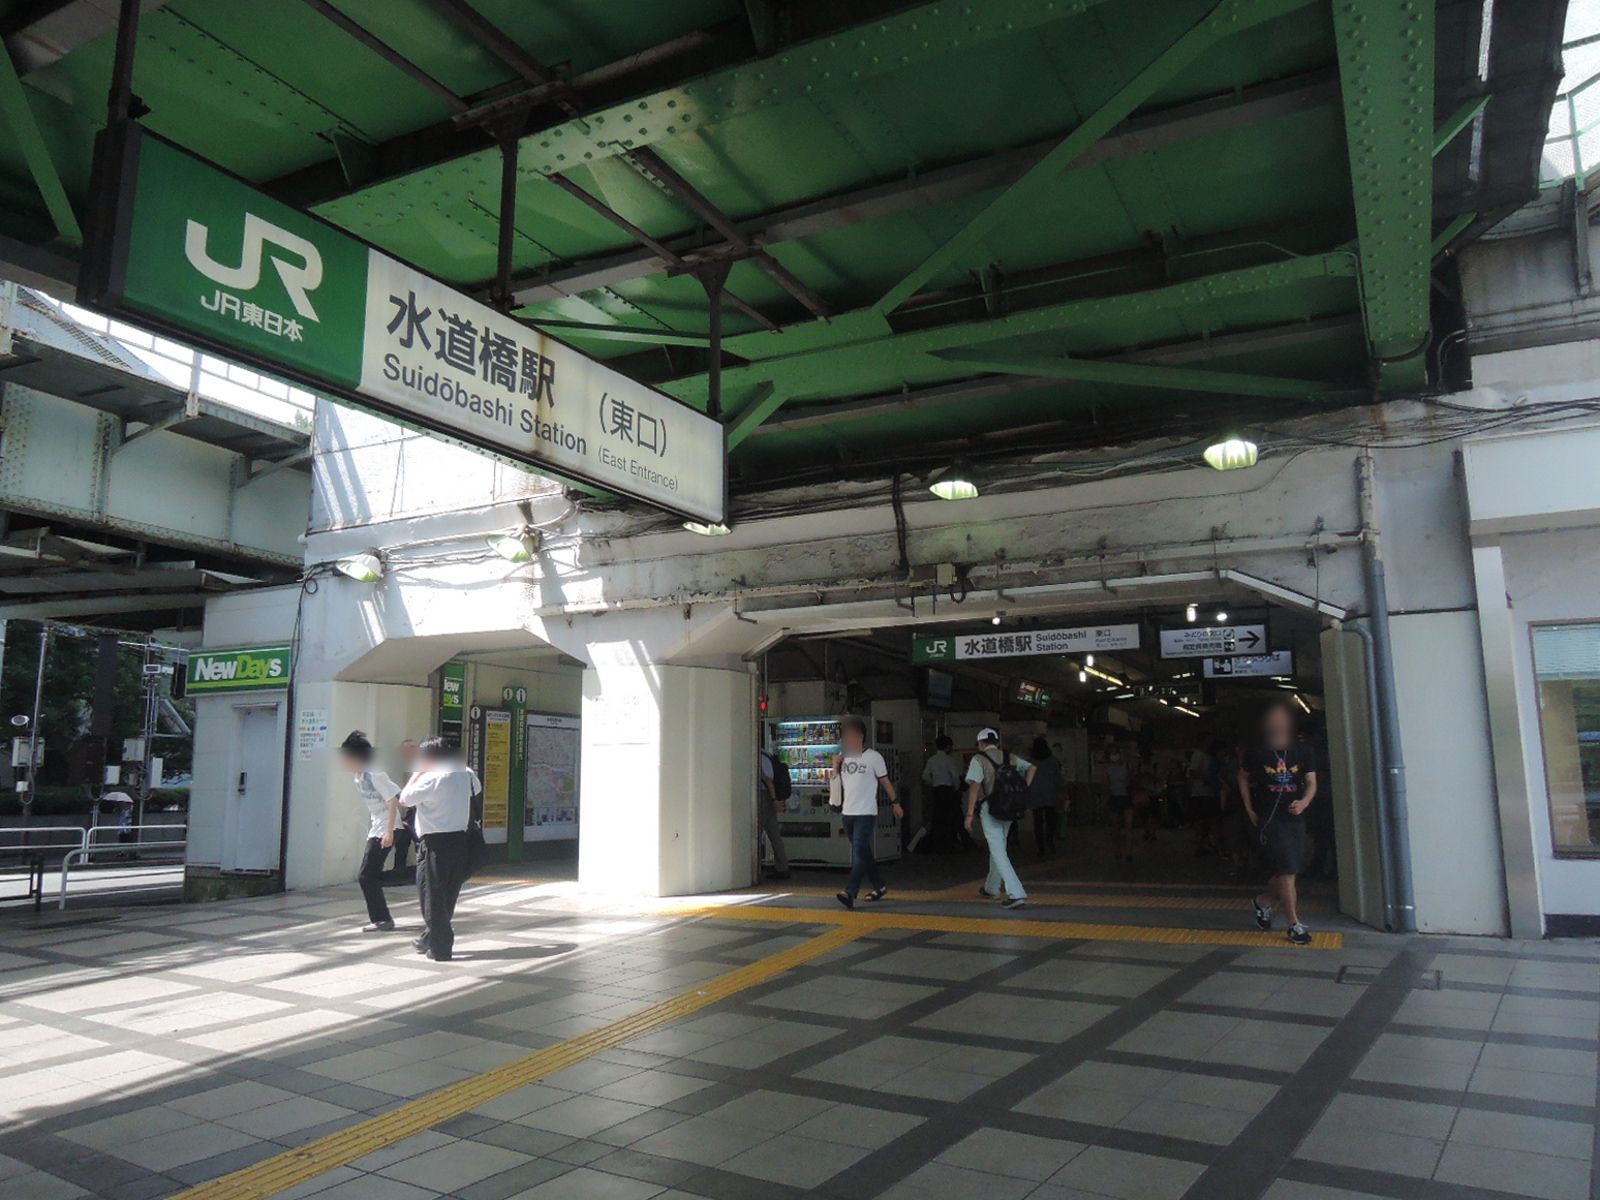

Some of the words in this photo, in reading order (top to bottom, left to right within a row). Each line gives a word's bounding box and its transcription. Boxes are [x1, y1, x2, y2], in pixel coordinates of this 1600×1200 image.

[185, 212, 323, 322] JR
[200, 289, 304, 343] JR東日本
[387, 291, 556, 409] 水道橋駅
[383, 353, 514, 430] Suidōbashi
[519, 398, 588, 456] Station
[597, 446, 628, 473] (East
[629, 456, 679, 492] Entrance)
[925, 640, 947, 653] JR
[964, 635, 1033, 656] 水道橋駅
[1035, 642, 1069, 652] Station
